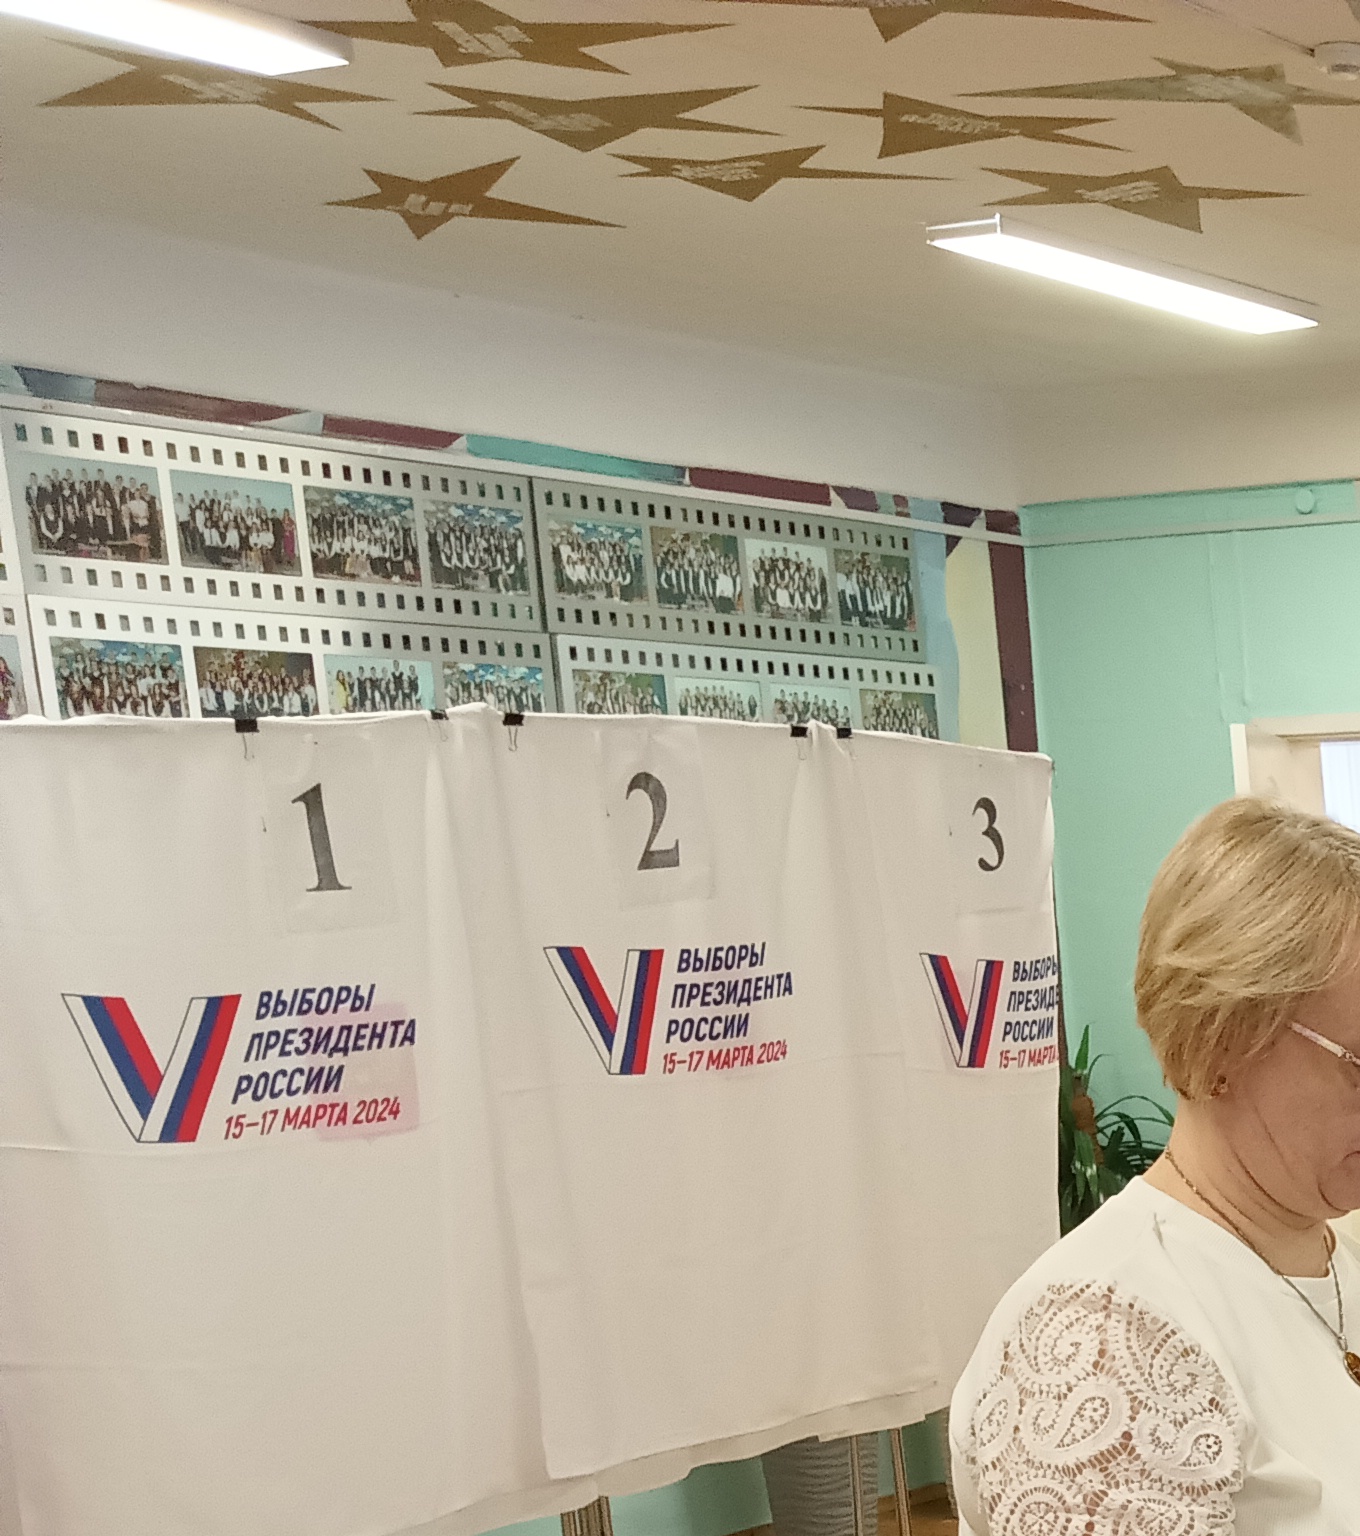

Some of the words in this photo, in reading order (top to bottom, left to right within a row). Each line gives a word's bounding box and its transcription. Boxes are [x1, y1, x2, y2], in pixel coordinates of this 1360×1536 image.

[291, 782, 352, 892] 1
[625, 771, 680, 871] 2
[972, 797, 1004, 872] 3
[676, 941, 766, 974] ВЫБОРЫ
[255, 983, 376, 1021] ВЫБОРЫ
[671, 971, 793, 1009] ПРЕЗИДЕНТА
[1006, 983, 1059, 1013] ПРЕЗИДЕ
[243, 1018, 416, 1063] ПРЕЗИДЕНТА
[665, 1012, 750, 1044] РОССИИ
[1001, 1015, 1055, 1043] РОССИИ
[706, 1044, 754, 1072] МАРТА
[756, 1039, 788, 1065] 2024
[1027, 1044, 1059, 1068] МАРТ
[231, 1064, 345, 1105] РОССИИ
[280, 1101, 348, 1133] МАРТА
[352, 1096, 401, 1126] 2024
